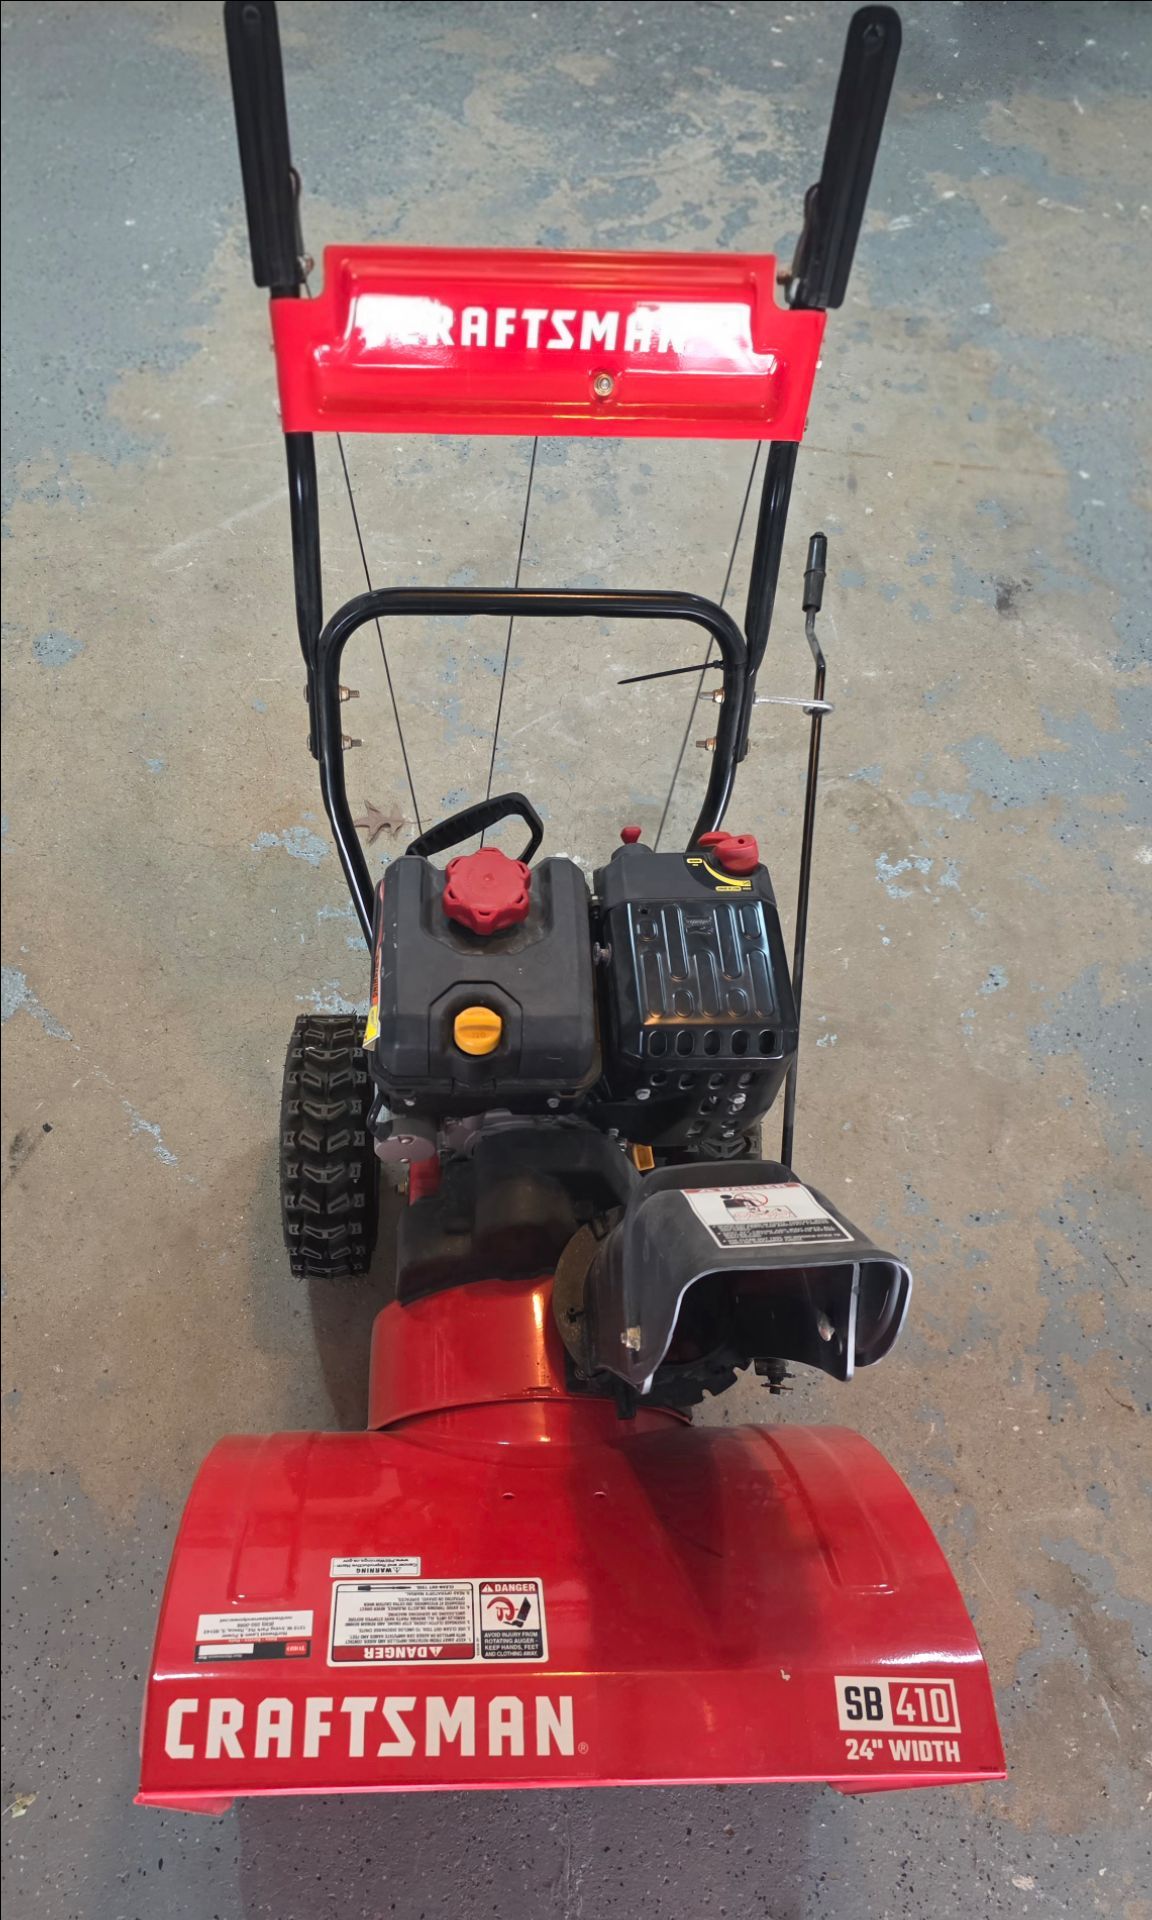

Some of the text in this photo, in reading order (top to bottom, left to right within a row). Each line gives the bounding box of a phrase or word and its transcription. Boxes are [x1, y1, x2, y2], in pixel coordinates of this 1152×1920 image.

[494, 1583, 535, 1592] DANGER
[364, 1647, 427, 1659] DANGER
[844, 1686, 950, 1723] SB 410
[845, 1738, 961, 1762] 24" WIDTH
